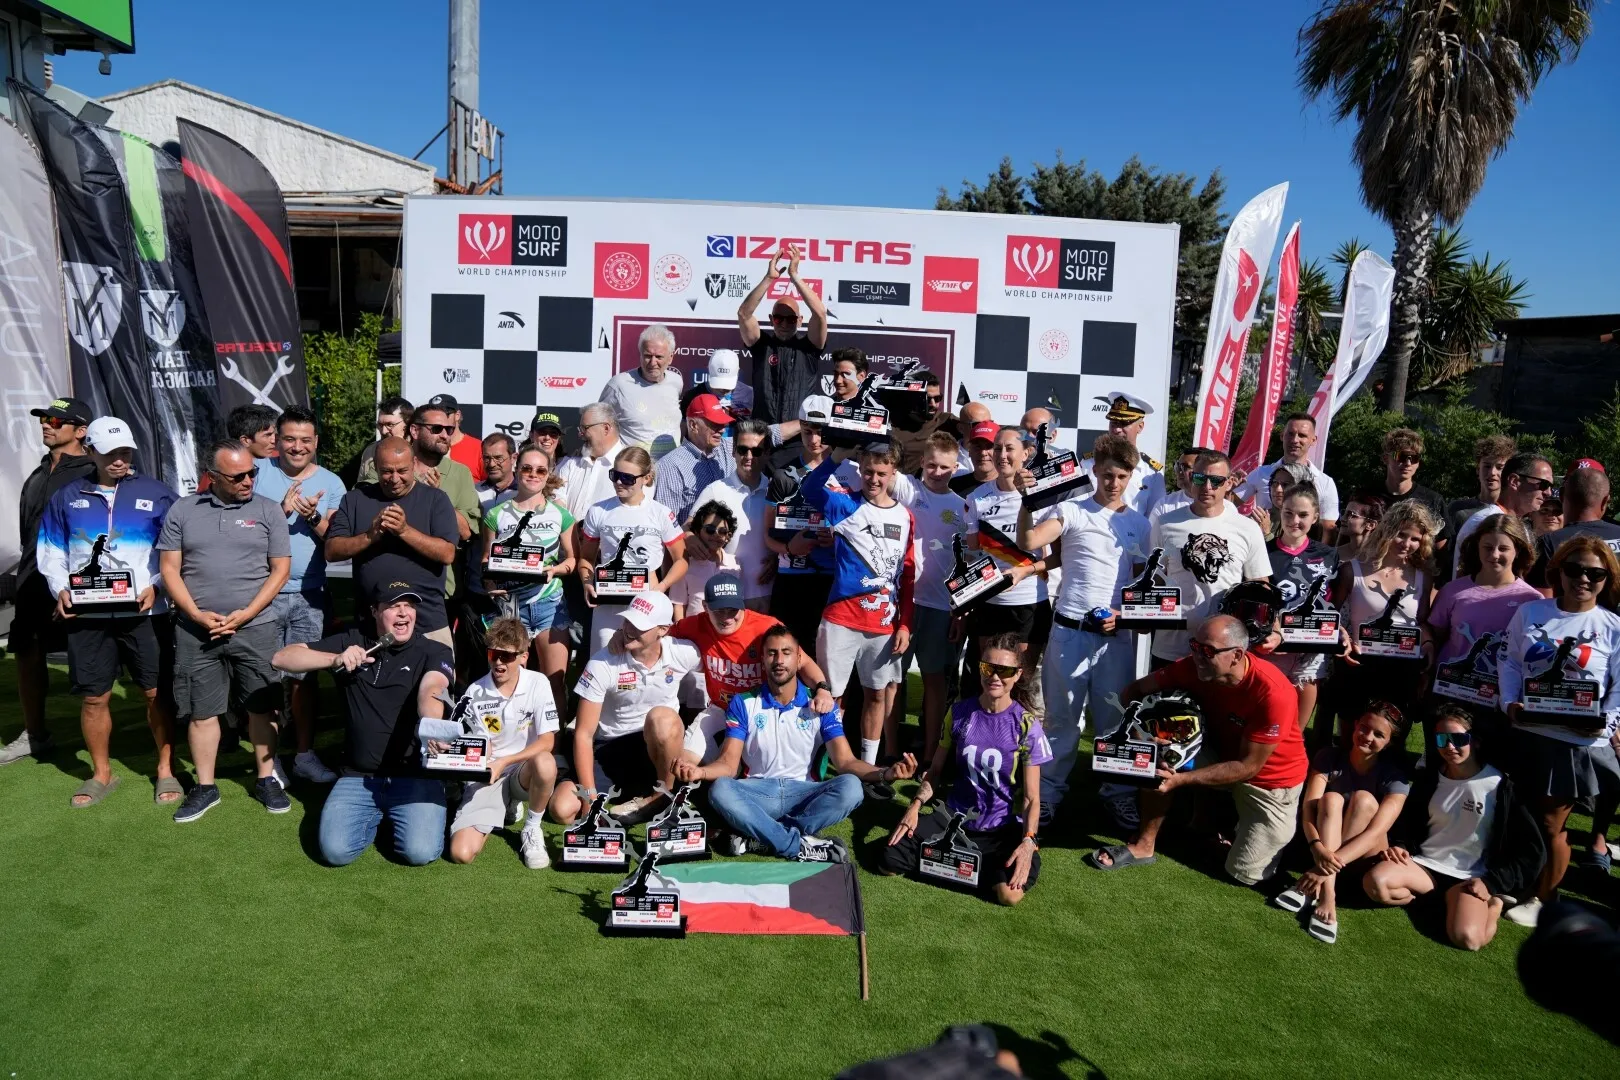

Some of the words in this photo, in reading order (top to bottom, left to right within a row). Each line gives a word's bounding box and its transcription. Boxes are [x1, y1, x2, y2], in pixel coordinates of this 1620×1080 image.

[518, 225, 561, 240] MOTO
[518, 241, 561, 257] SURF
[736, 236, 912, 266] IZELTAS
[1066, 249, 1108, 266] MOTO
[458, 268, 491, 276] WORLD
[495, 268, 567, 277] CHAMPIONSHIP
[1064, 265, 1108, 282] SURF
[728, 274, 747, 283] TEAM
[728, 282, 751, 291] RACING
[851, 284, 897, 295] SIFUNA
[940, 281, 959, 289] TMF
[728, 289, 744, 298] CLUB
[1004, 289, 1037, 298] WORLD
[1041, 291, 1112, 303] CHAMPIONSHIP
[1277, 301, 1288, 323] VE
[497, 320, 515, 329] ANTA
[552, 378, 572, 386] TMF
[1092, 404, 1109, 413] ANTA
[713, 583, 738, 592] HUSKI
[633, 597, 655, 612] HUSKI
[706, 655, 762, 678] HUSKI
[709, 670, 762, 688] WEAR
[1576, 692, 1591, 701] 1ST
[962, 744, 1003, 790] 18
[659, 905, 673, 913] 2ND
